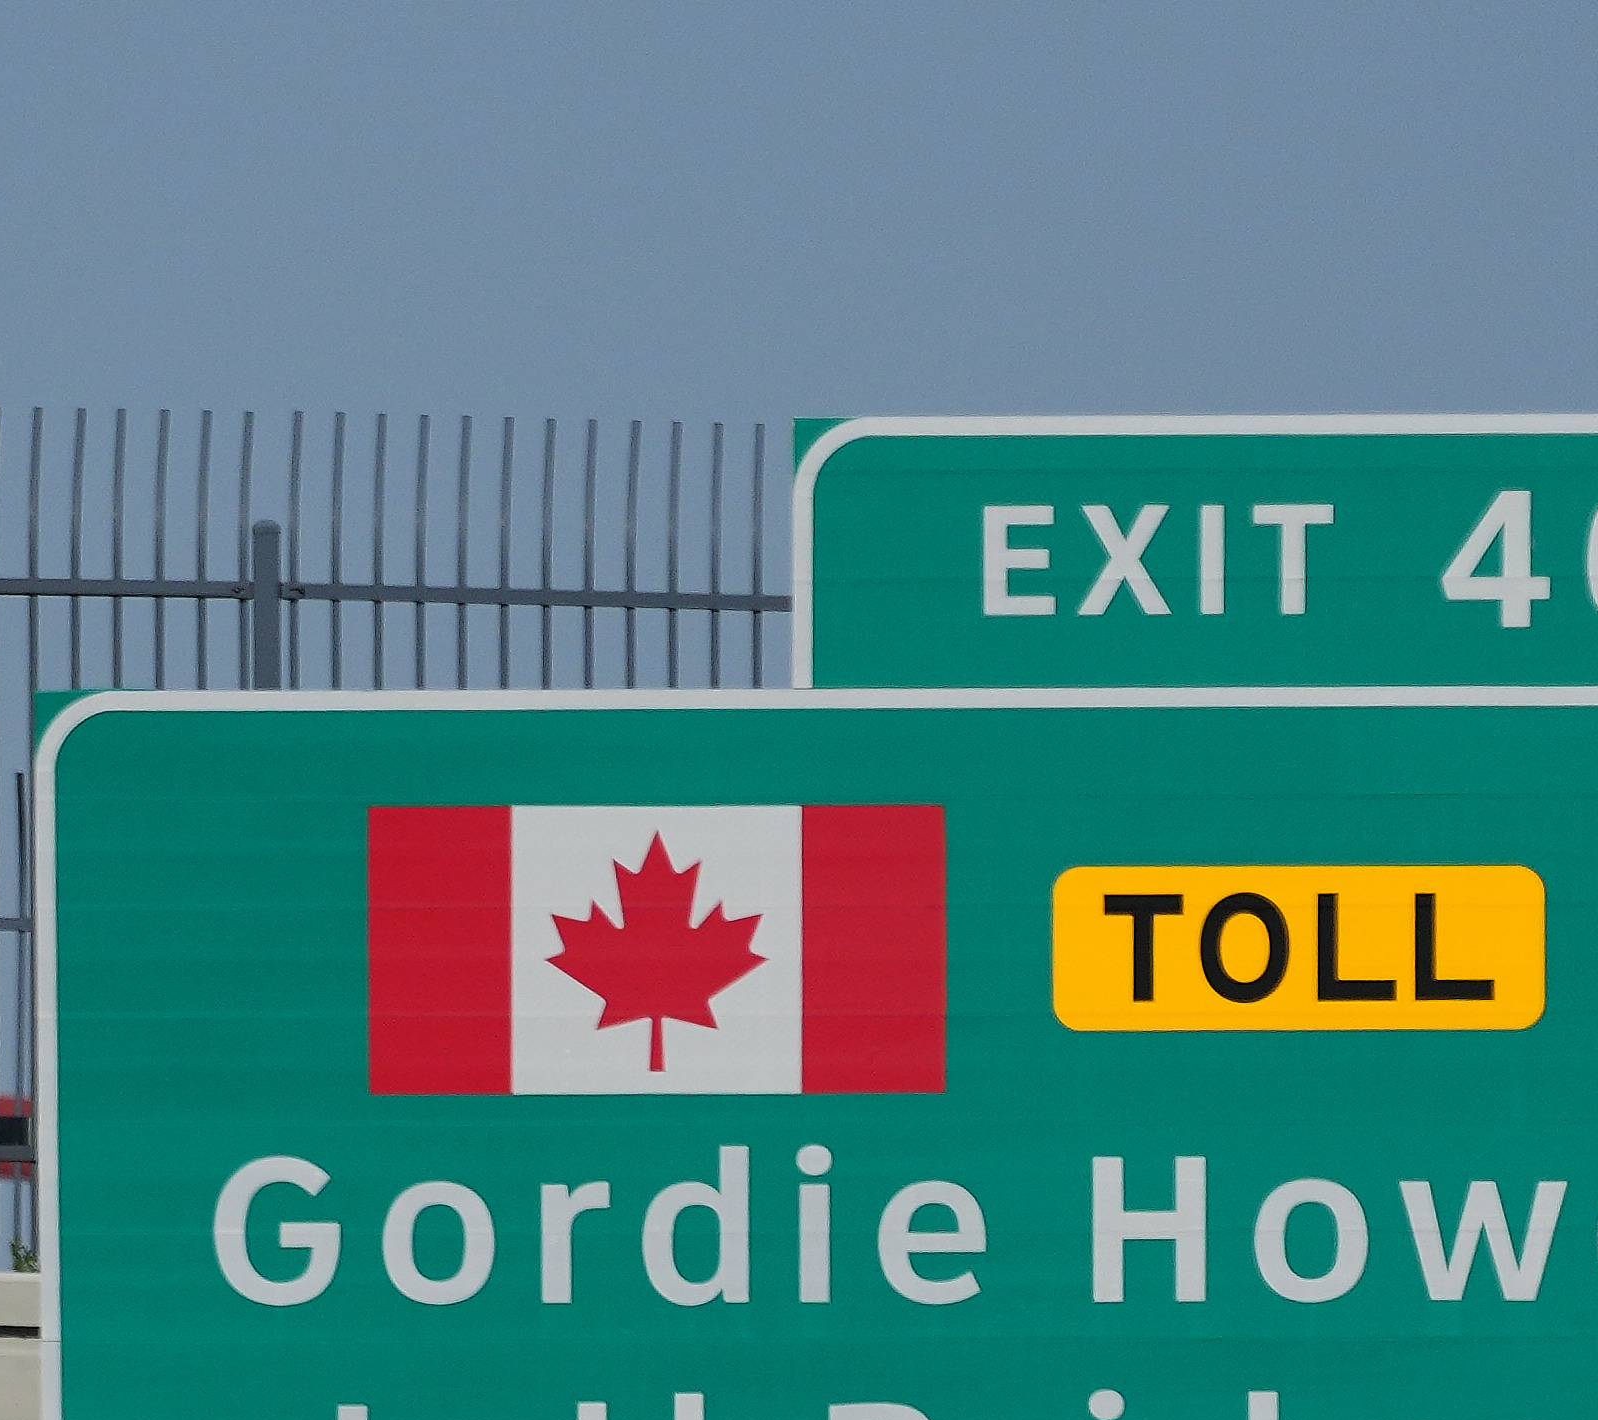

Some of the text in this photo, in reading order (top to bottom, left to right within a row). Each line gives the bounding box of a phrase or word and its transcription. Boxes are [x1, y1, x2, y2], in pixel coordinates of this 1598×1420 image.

[982, 502, 1335, 617] EXIT
[1102, 891, 1496, 1005] TOLL
[212, 1143, 988, 1308] Gordie
